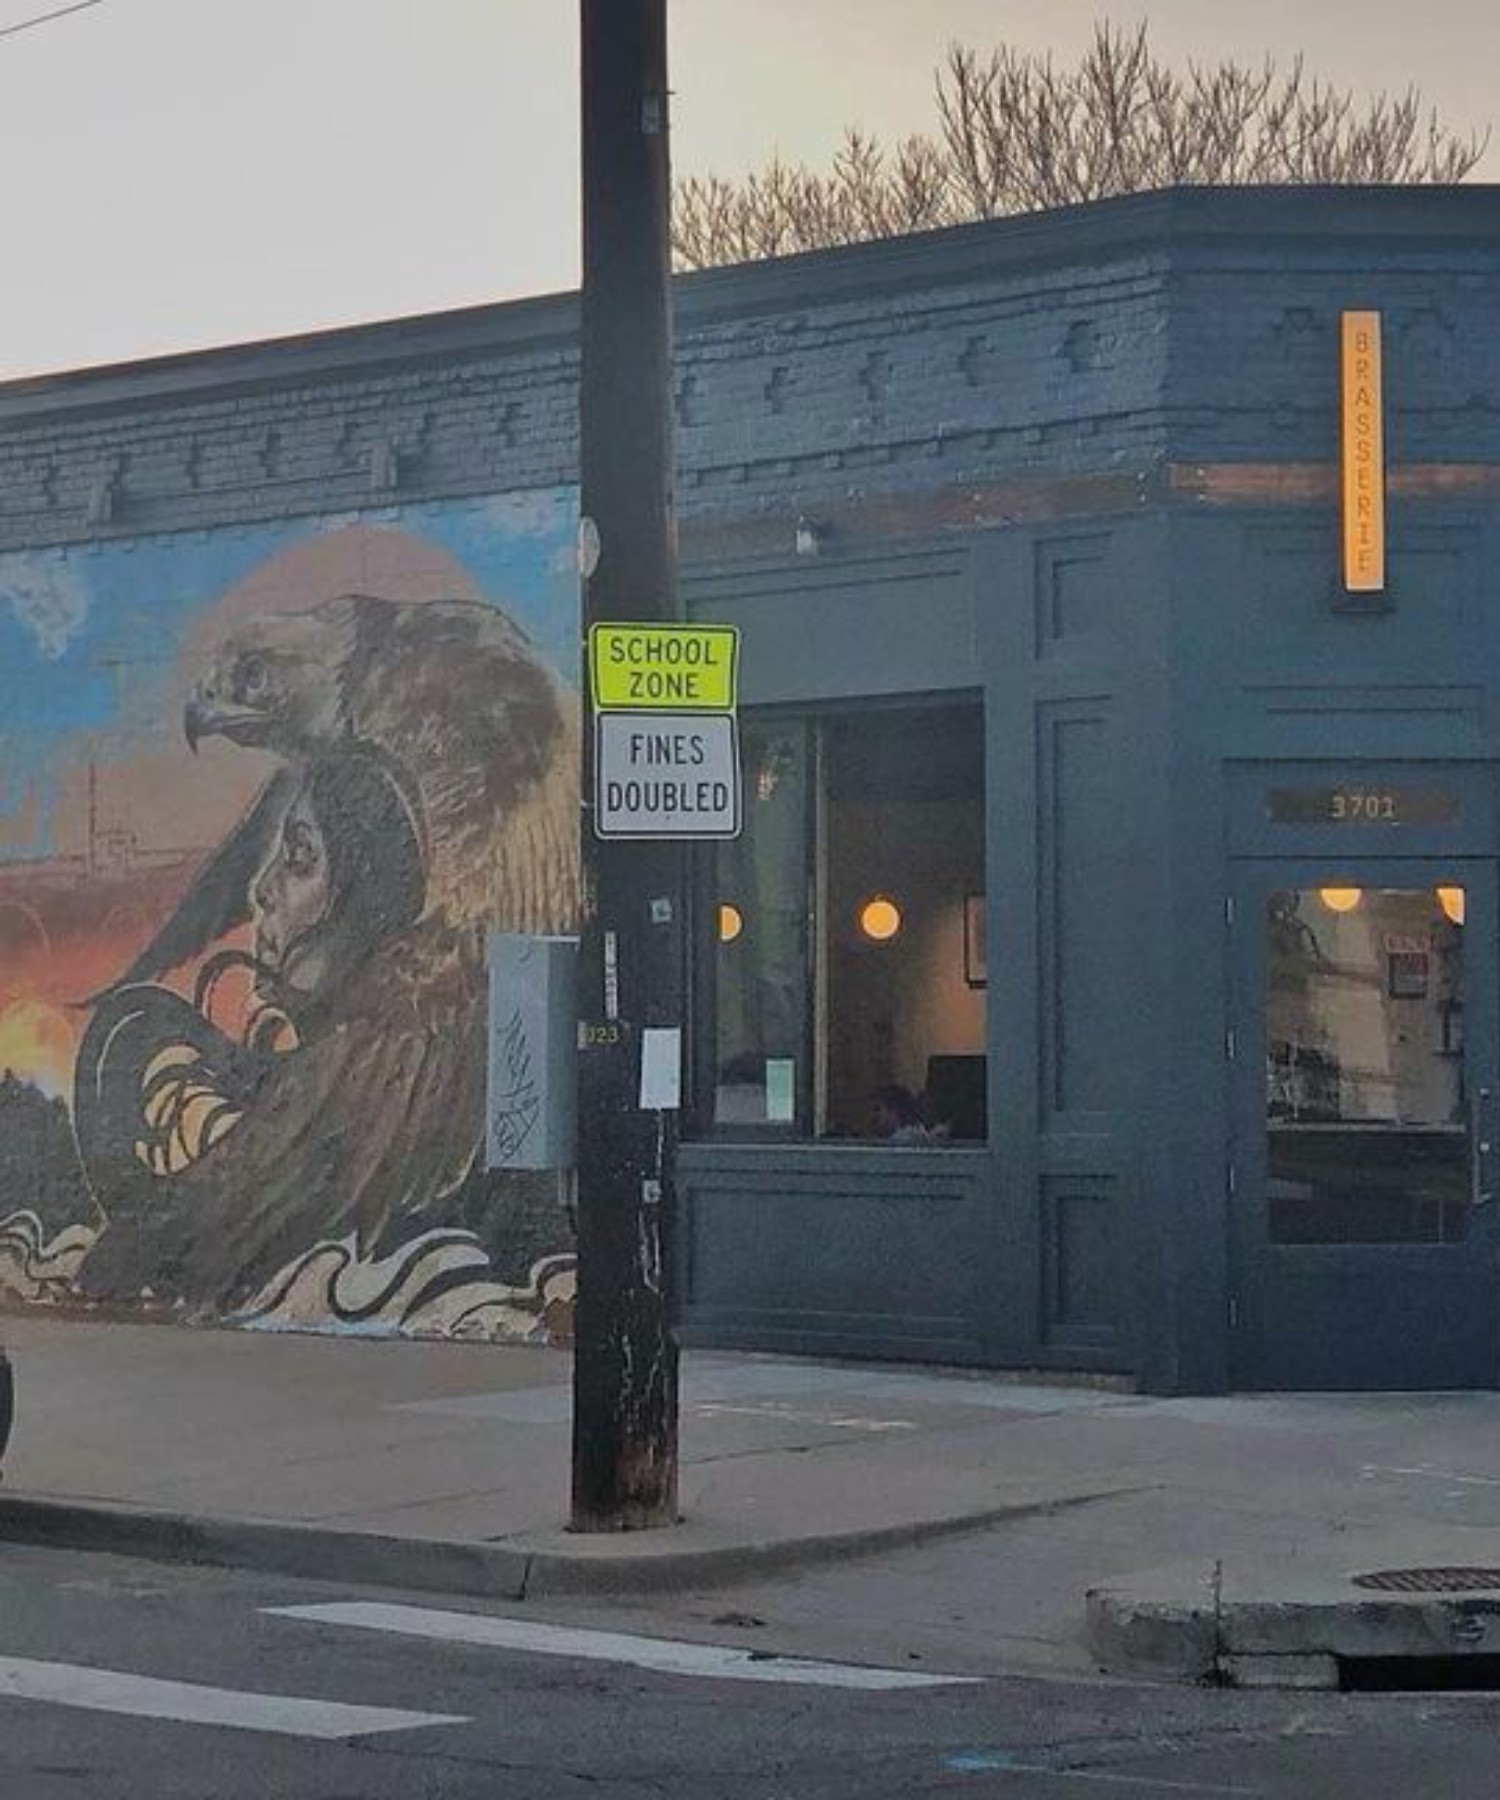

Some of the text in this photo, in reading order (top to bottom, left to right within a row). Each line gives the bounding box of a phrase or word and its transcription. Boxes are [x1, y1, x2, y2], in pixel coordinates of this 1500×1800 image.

[609, 637, 718, 665] SCHOOL
[629, 672, 700, 698] ZONE
[630, 734, 704, 764] FINES
[607, 782, 728, 812] DOUBLED
